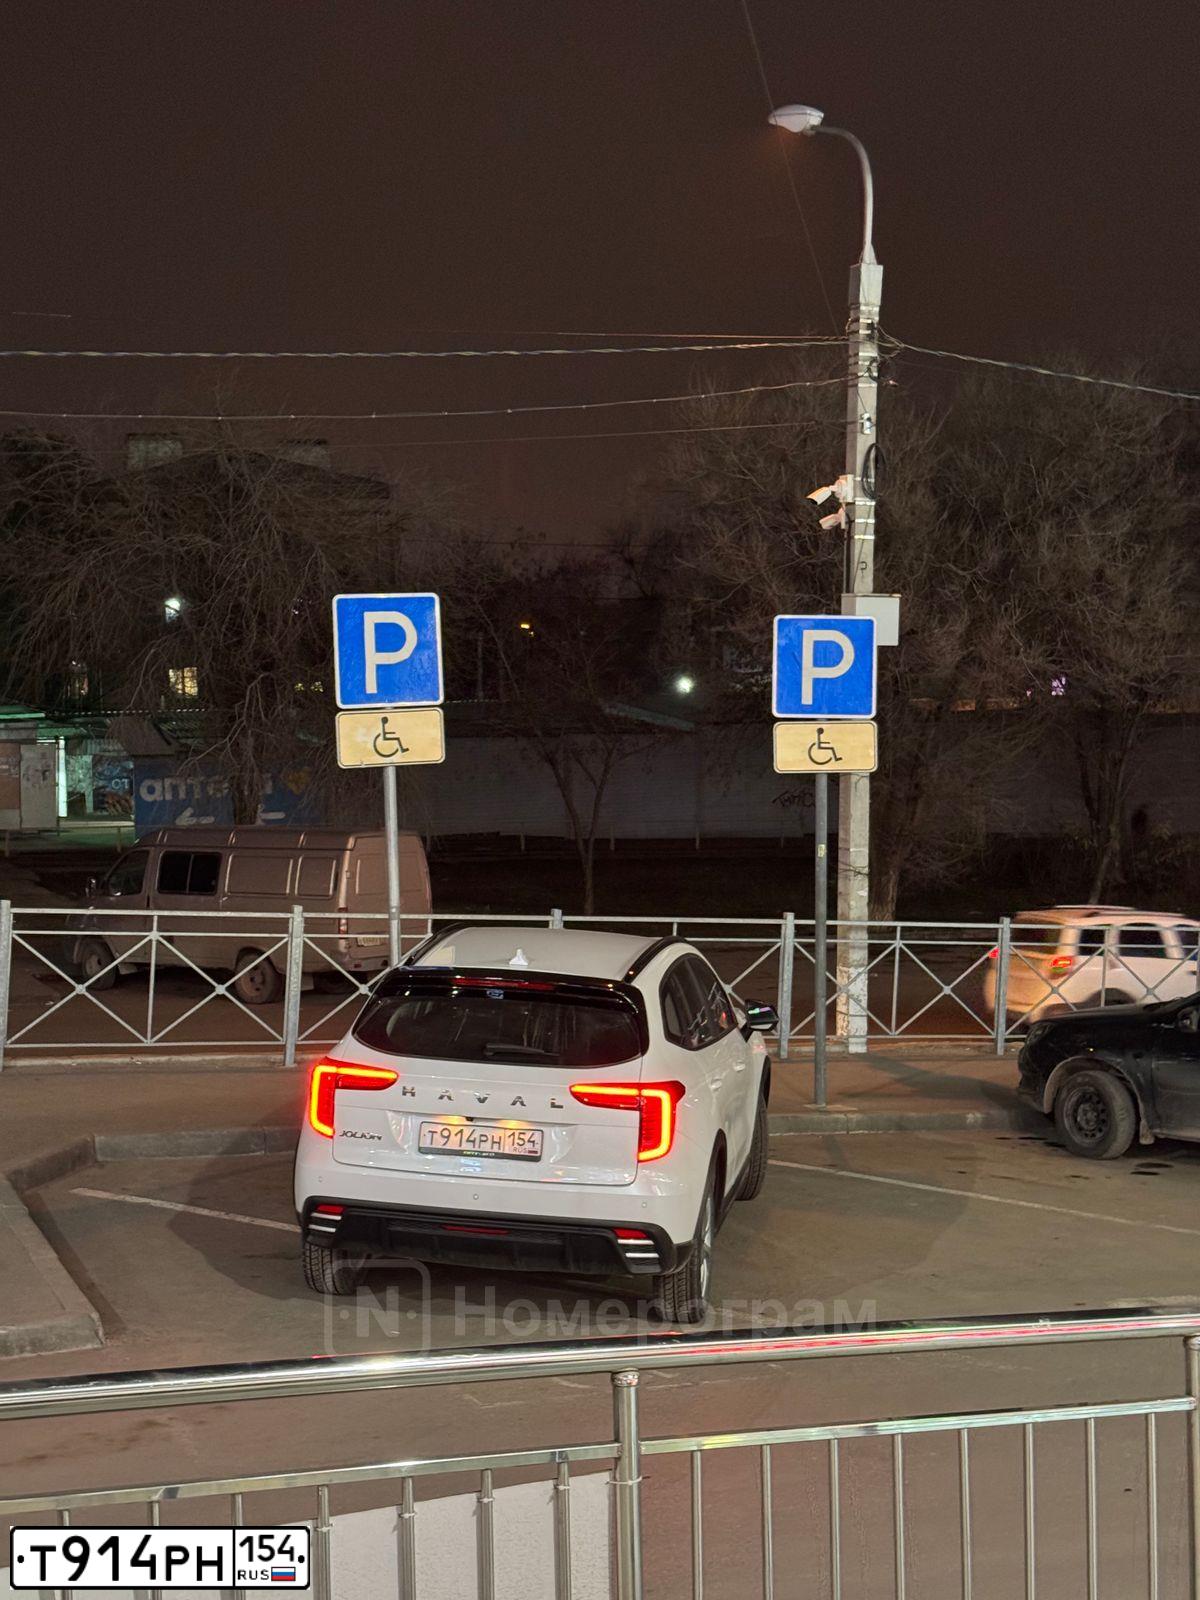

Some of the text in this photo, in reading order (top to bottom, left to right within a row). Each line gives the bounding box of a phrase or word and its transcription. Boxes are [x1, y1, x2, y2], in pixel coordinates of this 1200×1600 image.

[363, 611, 418, 694] P
[801, 629, 855, 705] P
[402, 1086, 564, 1109] HAVAL
[428, 1127, 536, 1151] Т914РН 154
